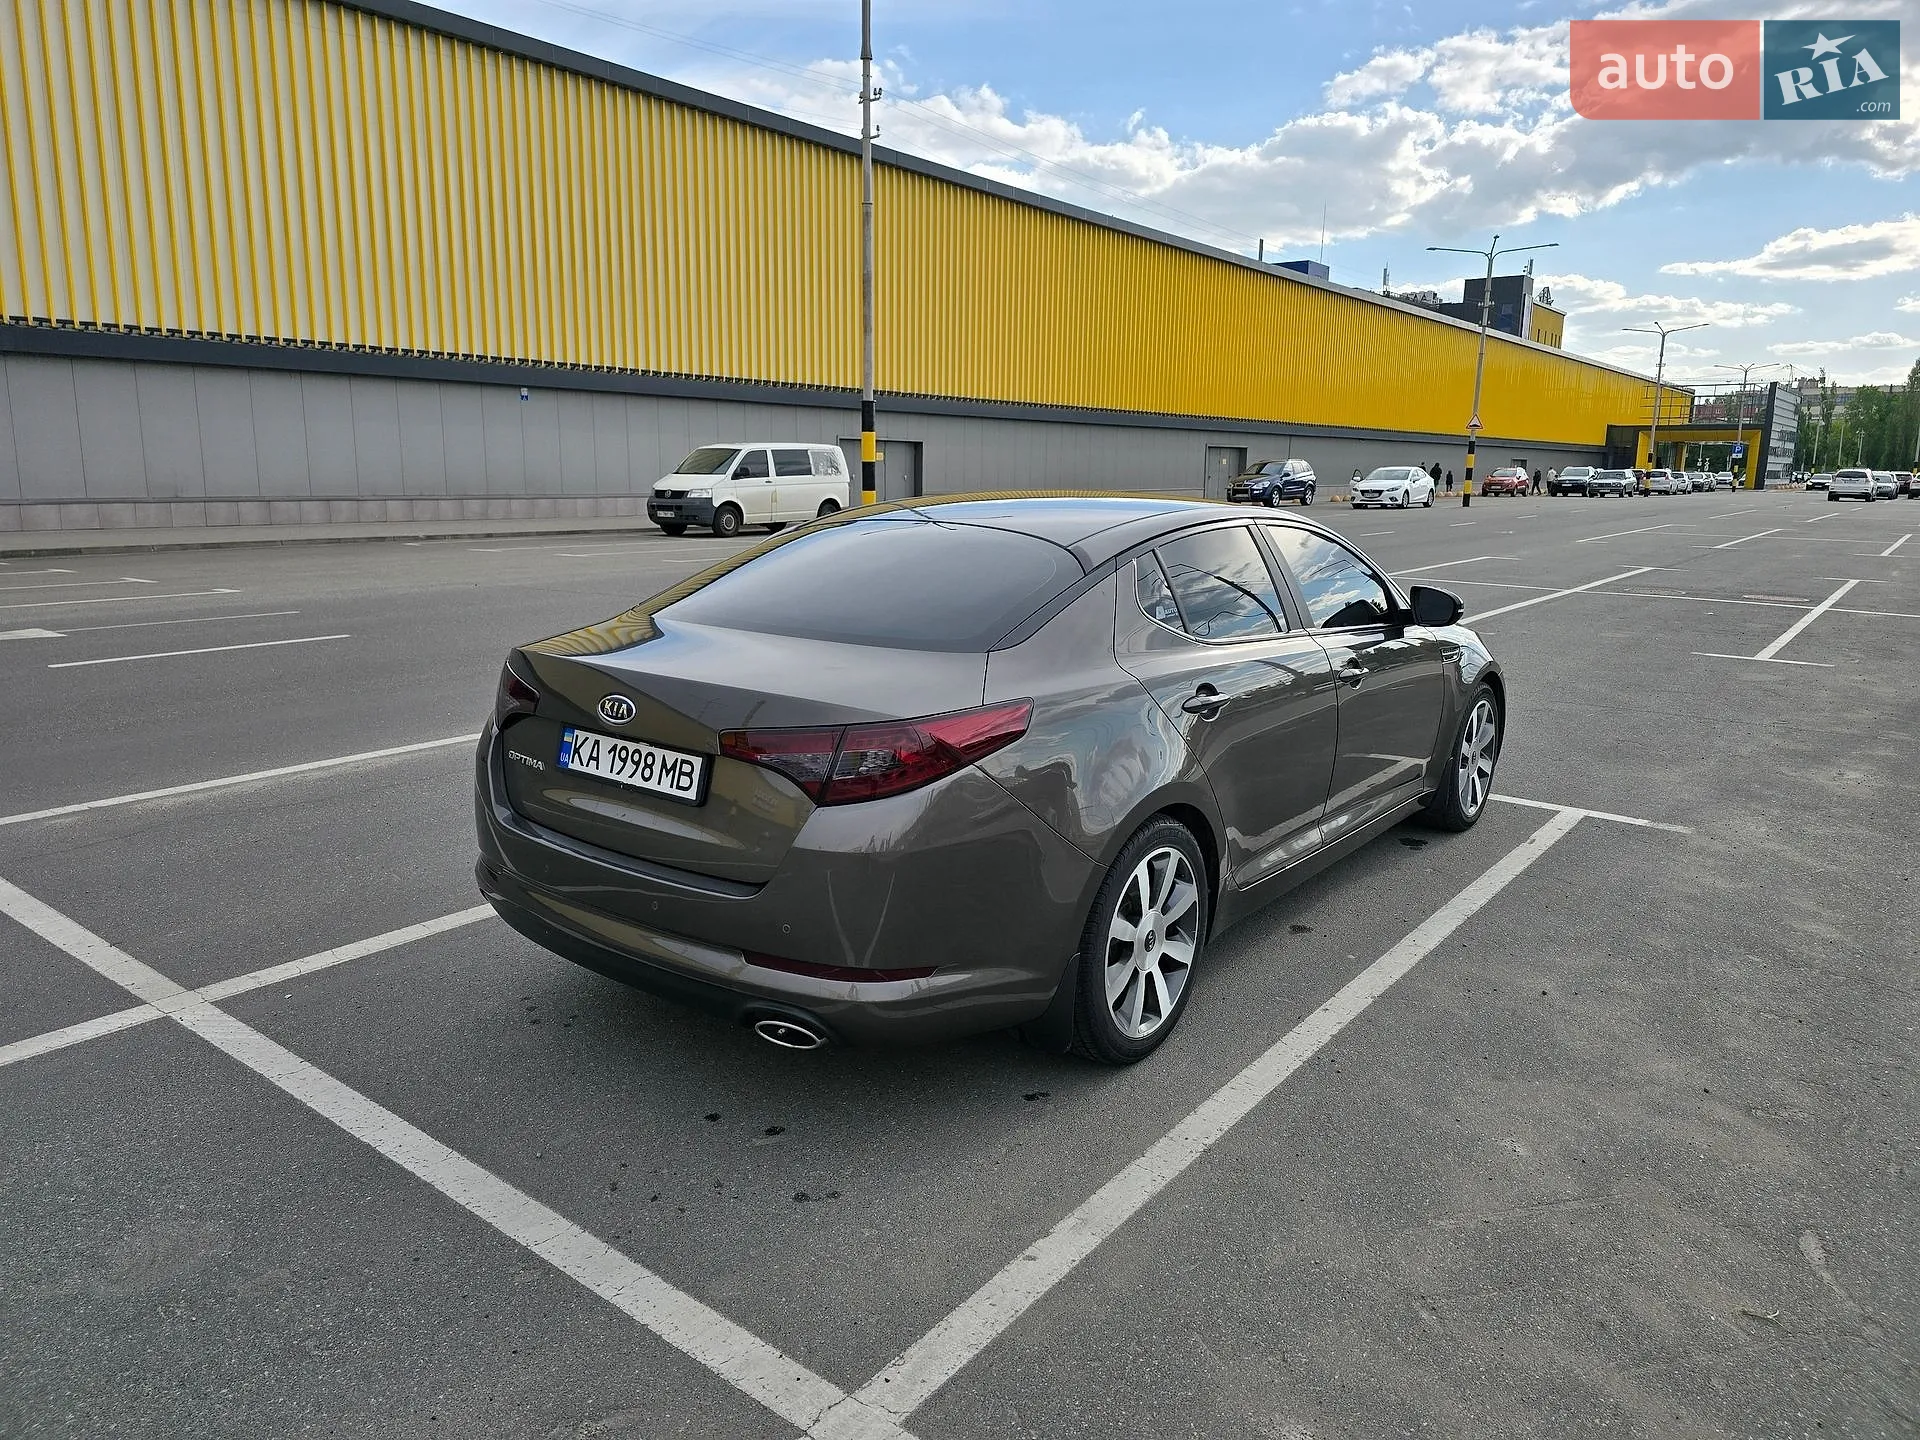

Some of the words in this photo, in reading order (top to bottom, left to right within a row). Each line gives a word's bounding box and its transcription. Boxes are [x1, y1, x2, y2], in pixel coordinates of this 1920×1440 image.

[603, 700, 628, 718] KIA
[508, 750, 544, 771] OPTIMA
[560, 752, 569, 763] UA
[571, 734, 601, 771] KA
[608, 743, 656, 782] 1998
[657, 754, 695, 792] MB
